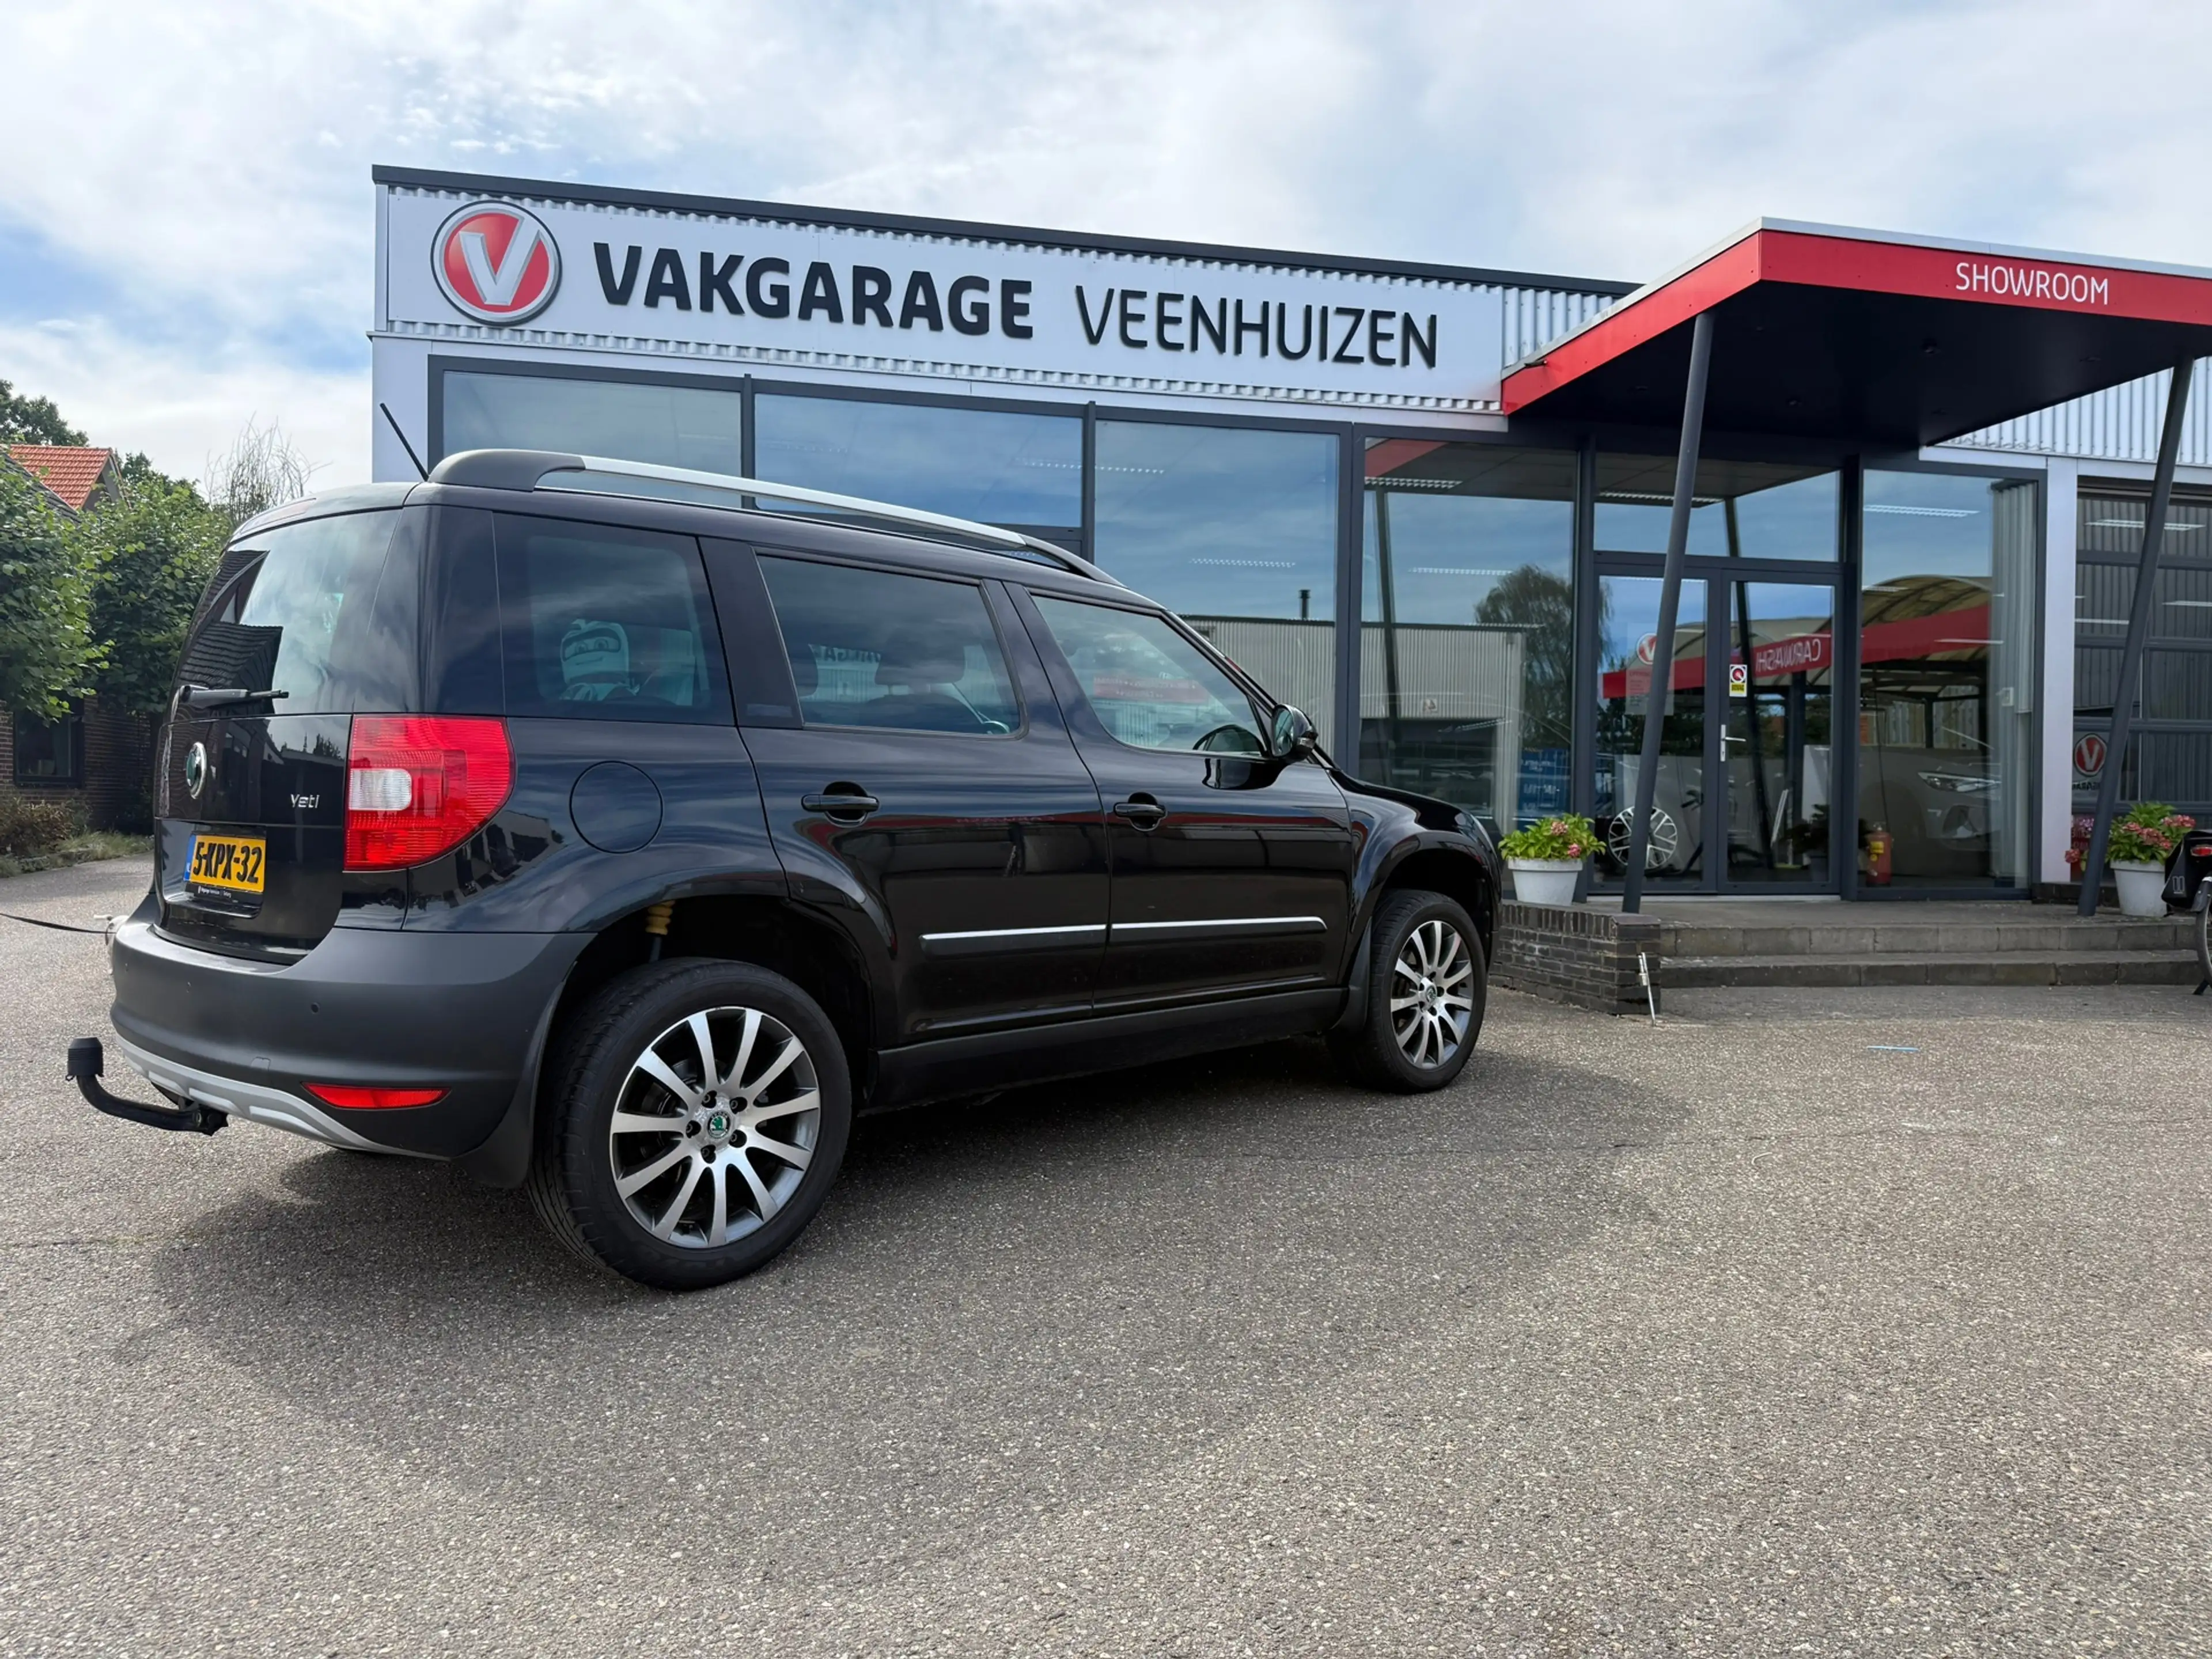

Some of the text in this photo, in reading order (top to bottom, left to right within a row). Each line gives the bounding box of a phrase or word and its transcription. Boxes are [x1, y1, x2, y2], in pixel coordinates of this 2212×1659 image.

[458, 209, 547, 306] V
[593, 241, 1438, 369] VAKGARAGE VEENHUIZEN
[1955, 262, 2108, 306] SHOWROOM
[290, 793, 320, 808] Yeti
[192, 841, 262, 884] 5-KPX-32
